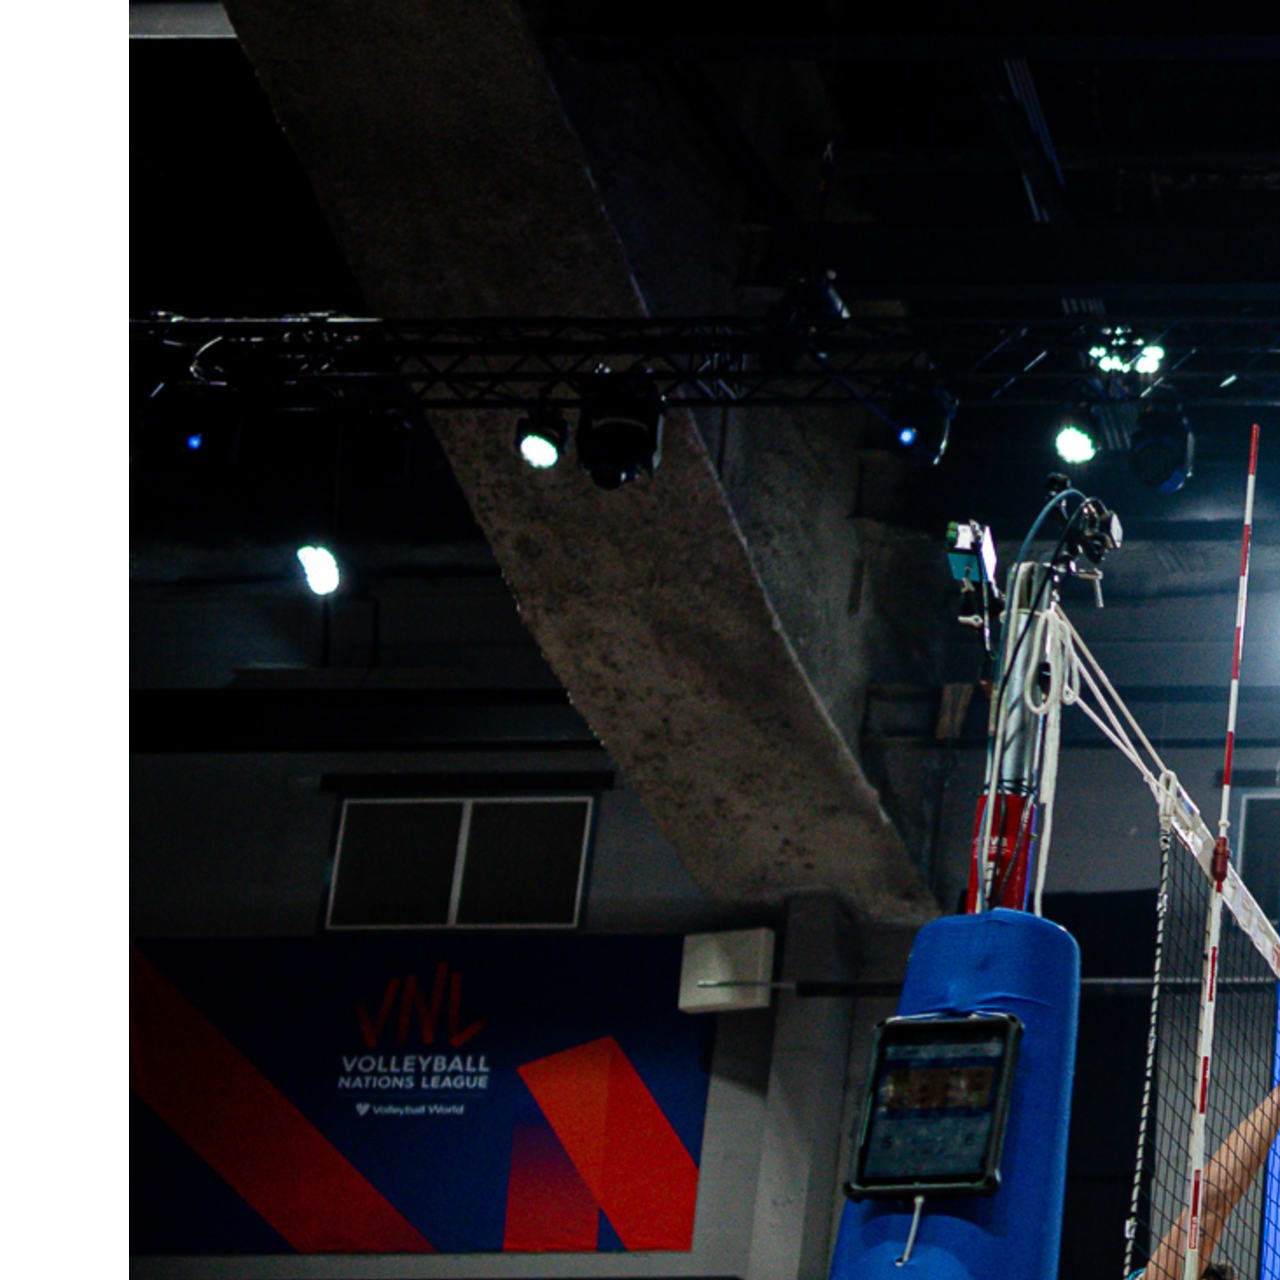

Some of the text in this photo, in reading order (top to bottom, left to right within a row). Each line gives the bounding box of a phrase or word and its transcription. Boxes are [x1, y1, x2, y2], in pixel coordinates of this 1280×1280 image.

[356, 961, 490, 1047] VNL
[341, 1055, 491, 1073] VOLLEYBALL
[337, 1075, 489, 1090] NATIONS LEAGUE
